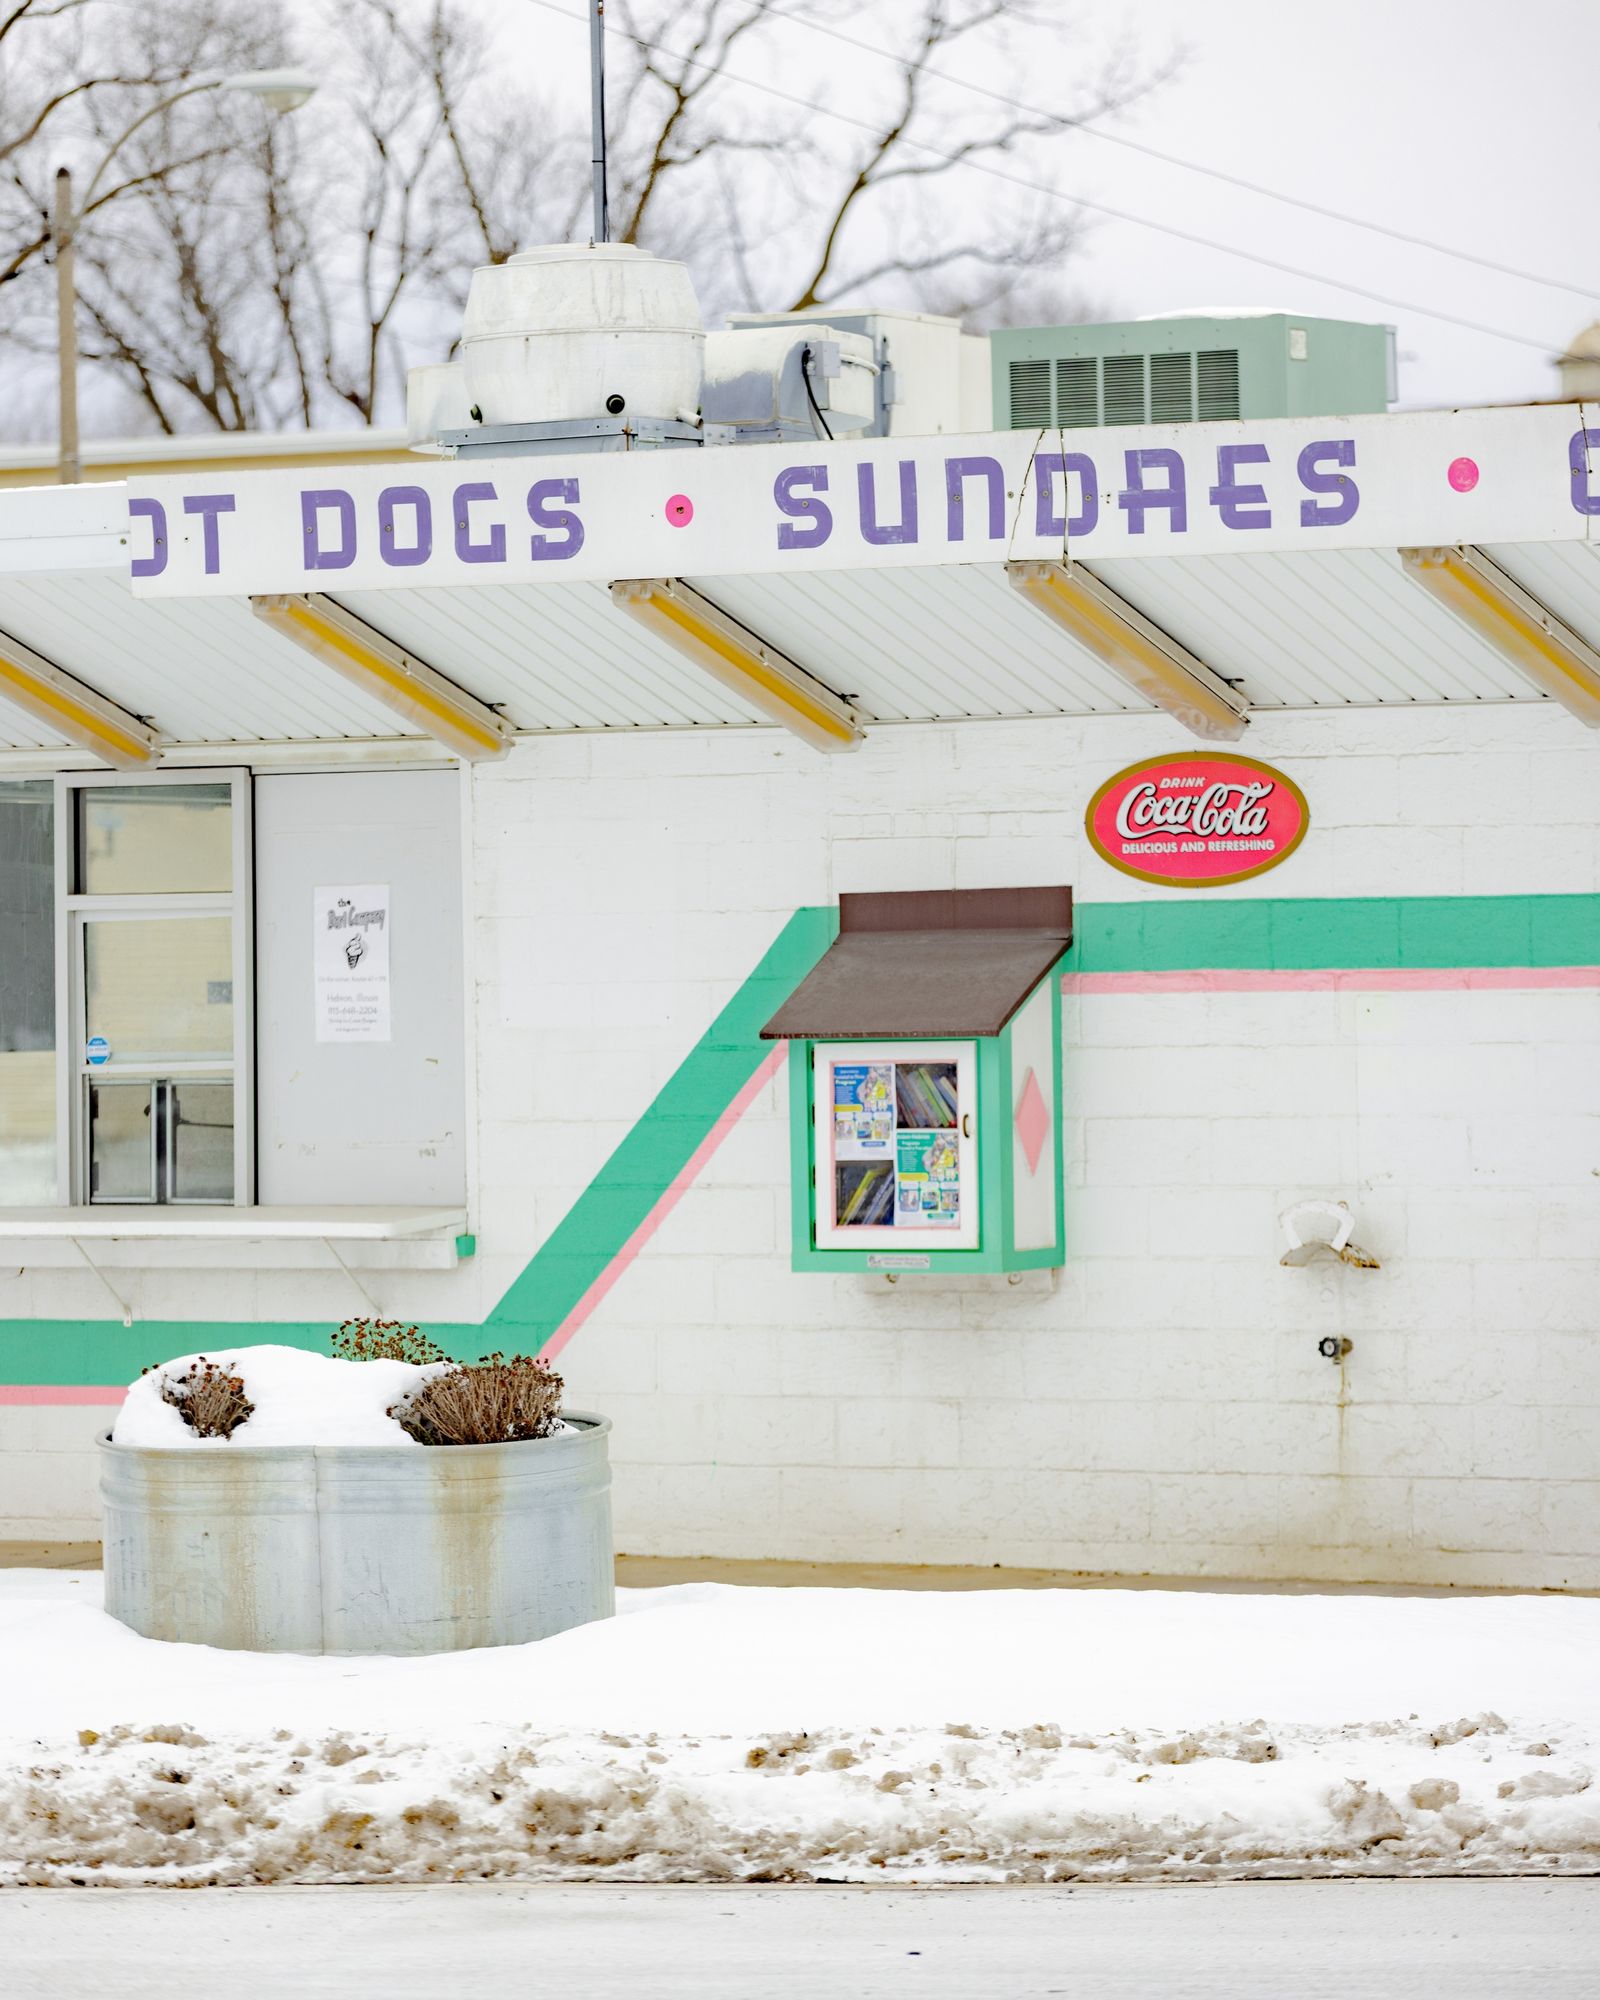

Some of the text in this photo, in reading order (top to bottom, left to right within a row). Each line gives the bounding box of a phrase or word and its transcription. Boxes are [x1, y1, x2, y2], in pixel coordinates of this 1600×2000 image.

[301, 478, 585, 571] DOGS
[774, 439, 1360, 550] SUNDAES
[1160, 777, 1205, 789] DRINK
[1116, 782, 1274, 840] Coca-Cola
[1121, 838, 1276, 855] DELICIOUS AND REFRESHING
